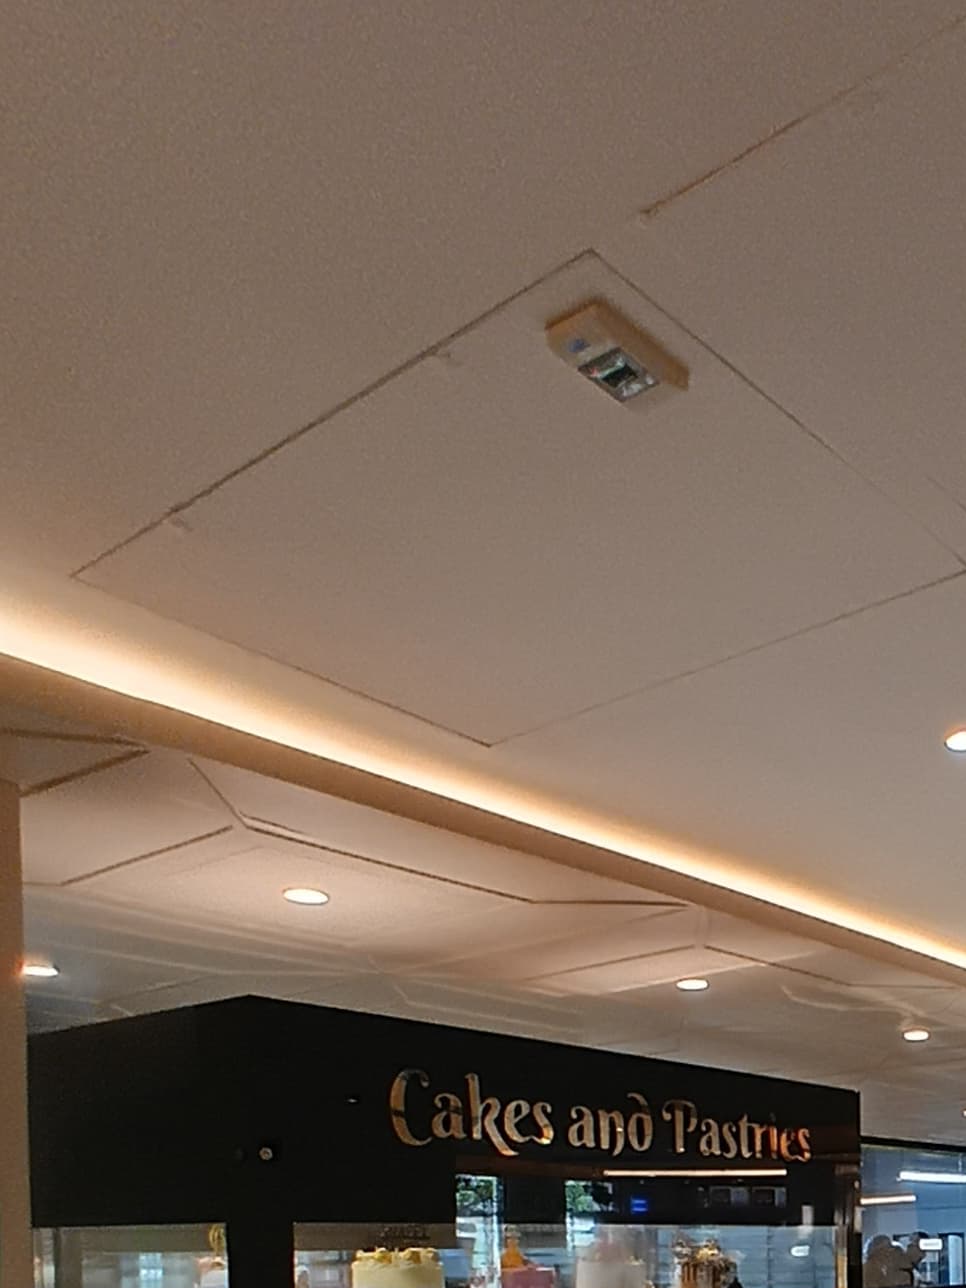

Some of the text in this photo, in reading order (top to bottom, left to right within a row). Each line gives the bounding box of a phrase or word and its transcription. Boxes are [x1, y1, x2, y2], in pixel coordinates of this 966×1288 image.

[389, 1068, 811, 1162] Cakes and Pastries
